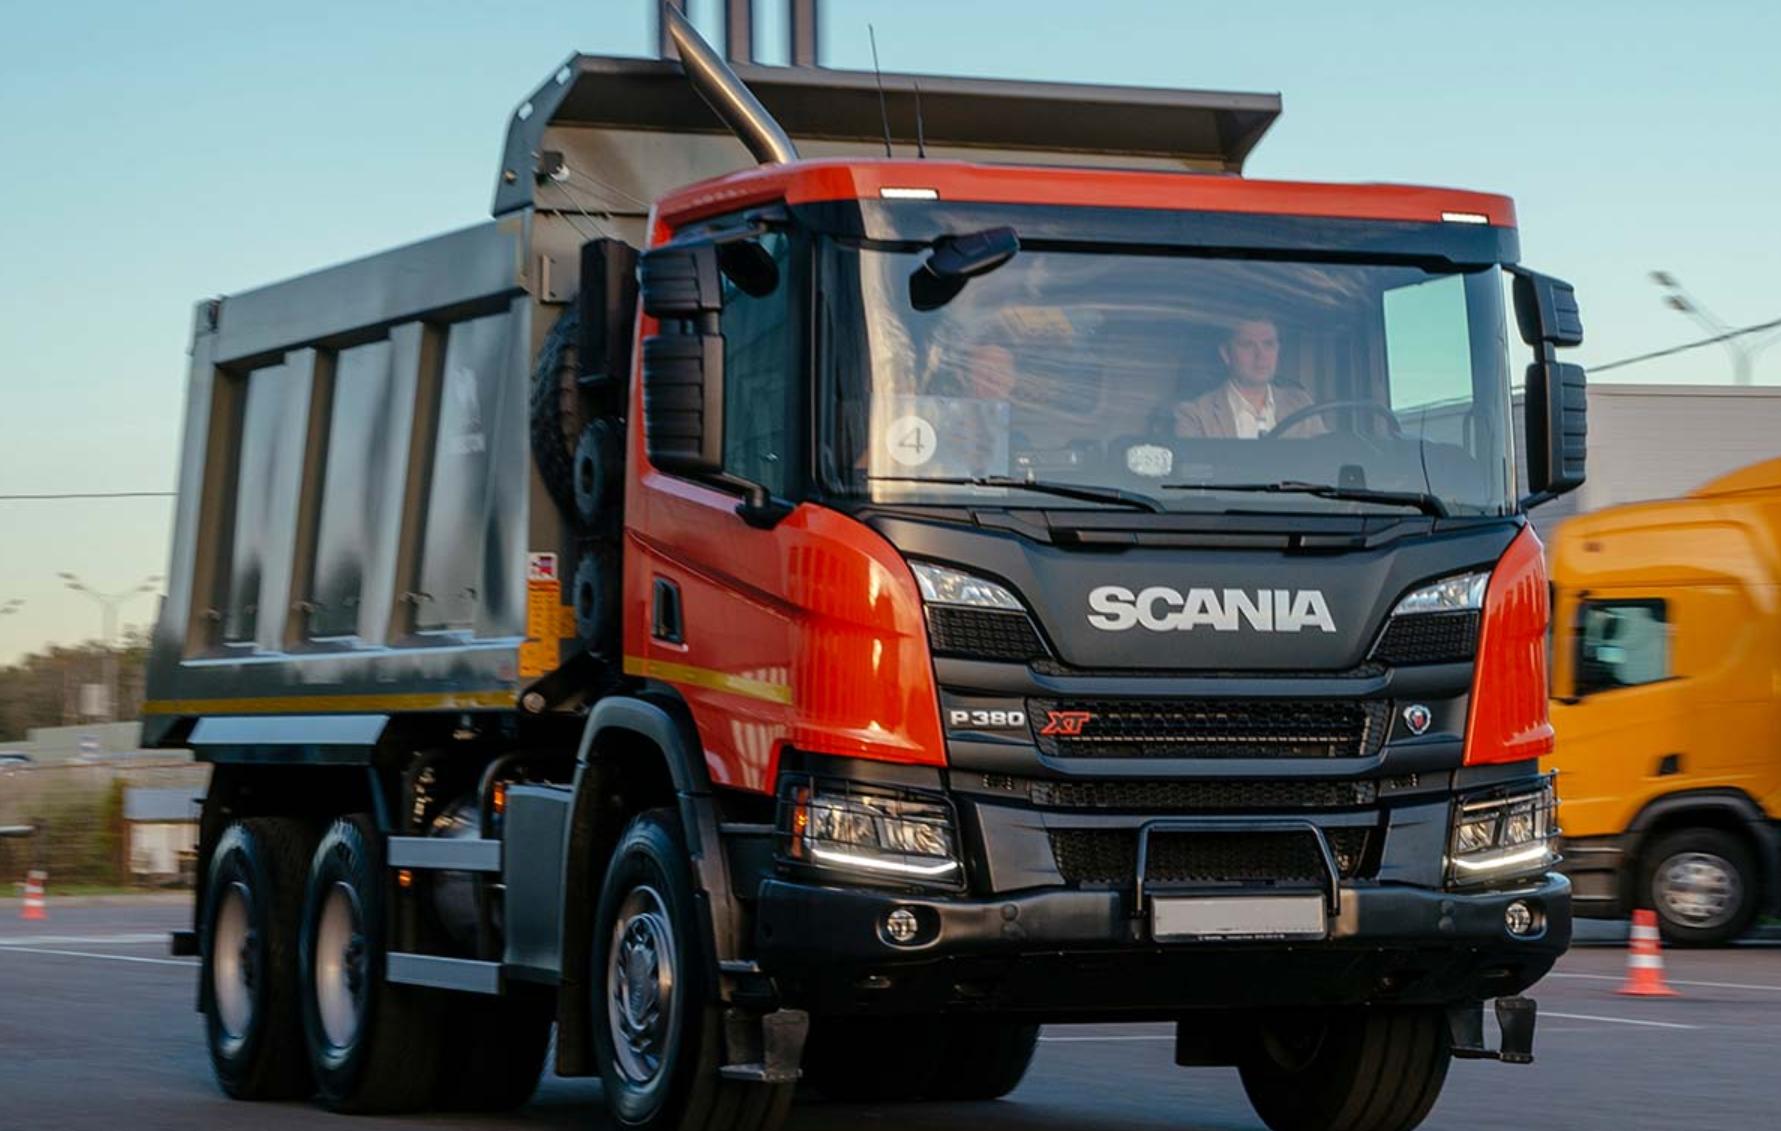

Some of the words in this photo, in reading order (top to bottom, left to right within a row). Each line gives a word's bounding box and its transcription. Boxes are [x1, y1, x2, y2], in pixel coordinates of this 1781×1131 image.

[898, 427, 924, 453] 4
[1087, 585, 1337, 632] SCANIA
[1041, 711, 1090, 735] XT
